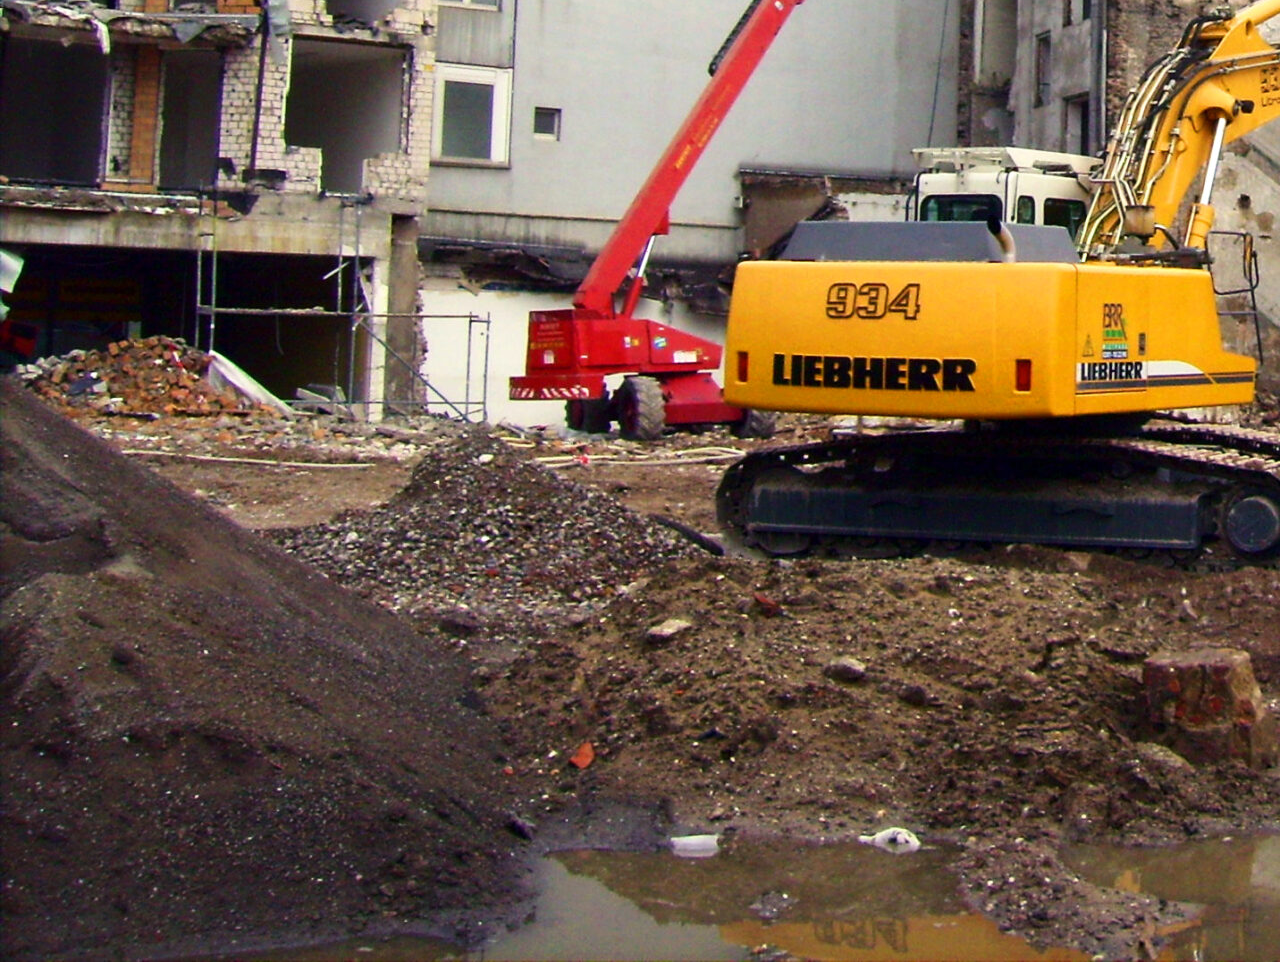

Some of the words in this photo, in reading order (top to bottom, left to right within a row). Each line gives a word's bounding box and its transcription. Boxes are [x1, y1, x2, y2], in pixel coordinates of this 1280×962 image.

[825, 282, 921, 320] 934
[772, 353, 977, 392] LIEBHERR
[1081, 361, 1143, 381] LIEBHERR
